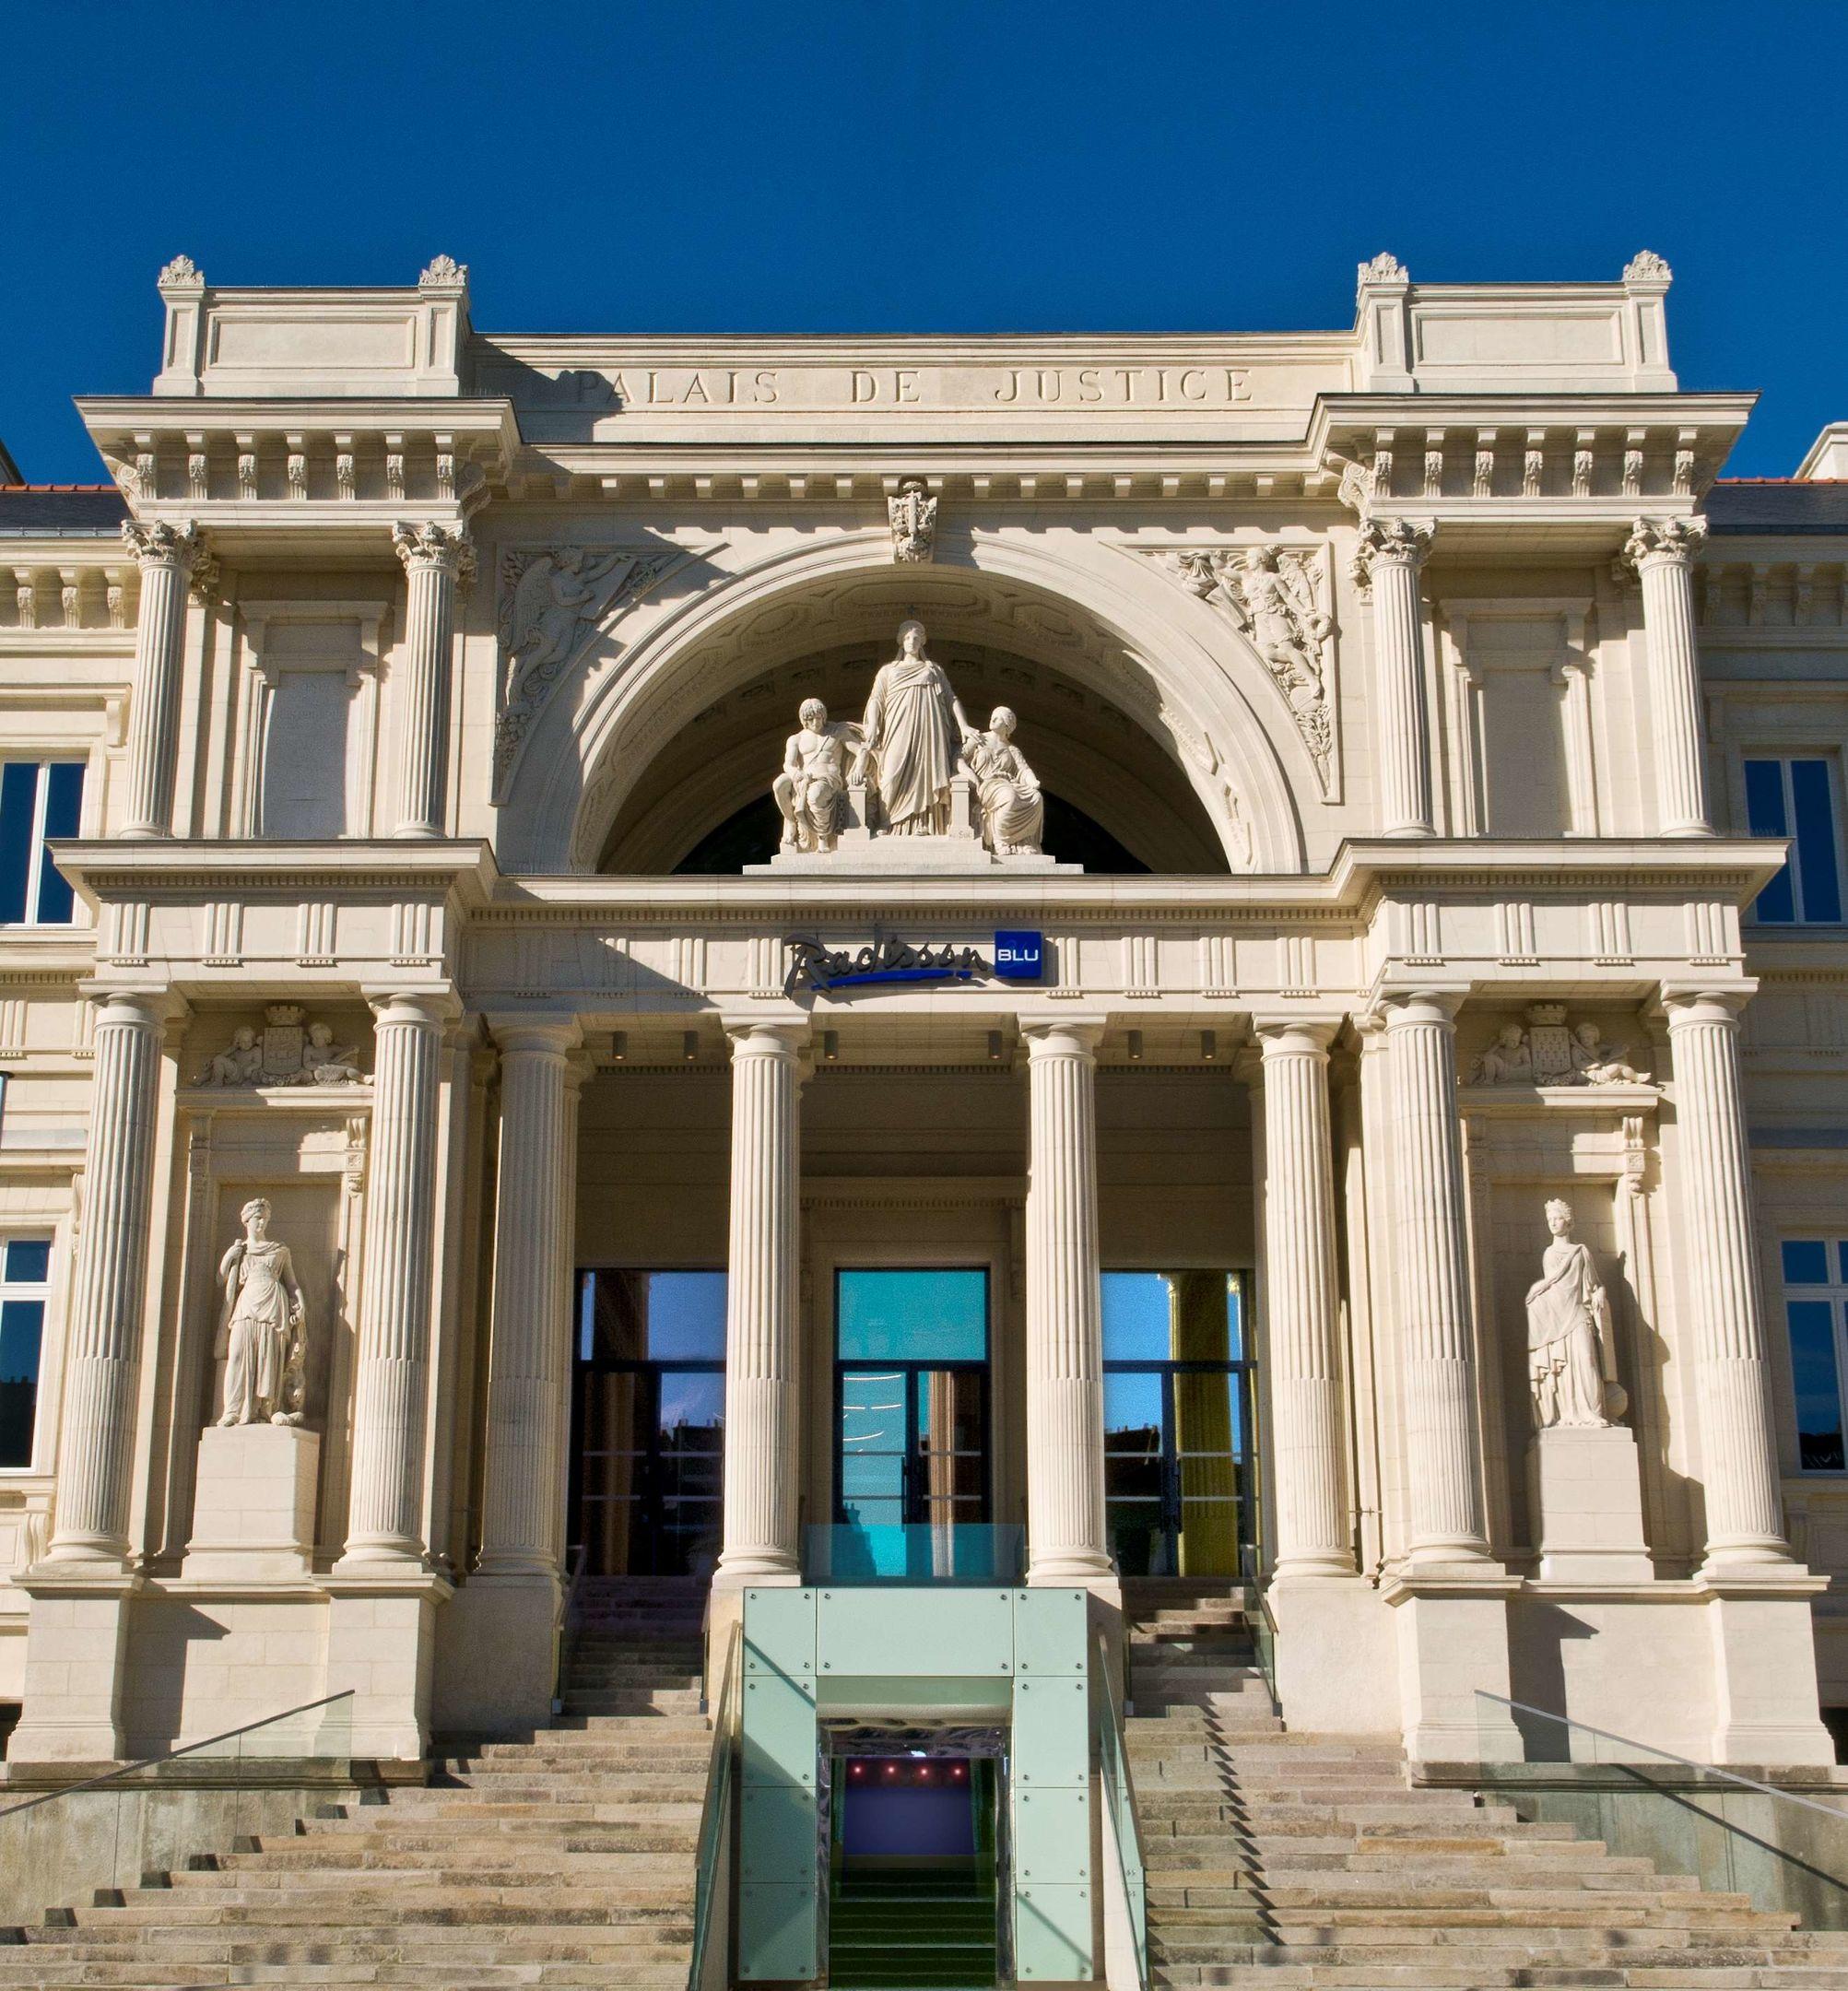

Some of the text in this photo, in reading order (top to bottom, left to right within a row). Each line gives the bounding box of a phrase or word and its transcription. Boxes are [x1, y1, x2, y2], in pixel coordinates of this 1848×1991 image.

[576, 369, 1253, 404] PALAIS DE JUSTICE
[783, 924, 1039, 999] Radisson BLU
